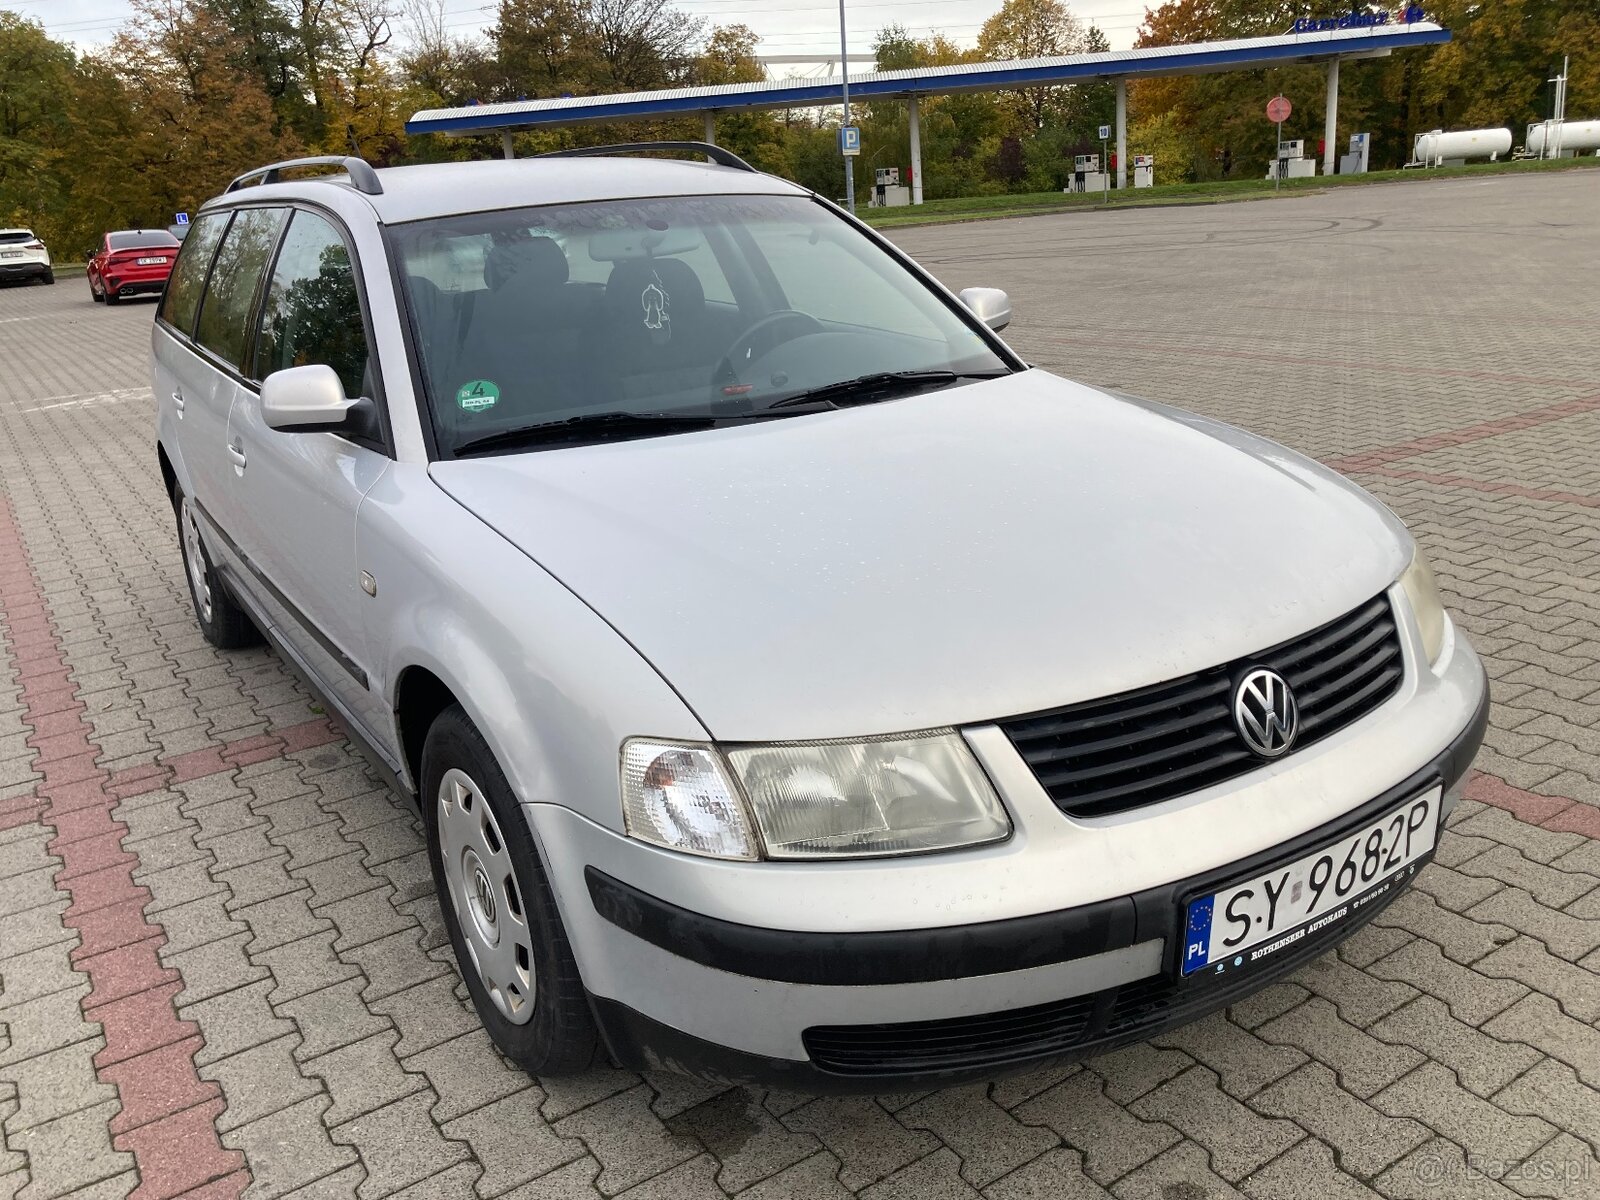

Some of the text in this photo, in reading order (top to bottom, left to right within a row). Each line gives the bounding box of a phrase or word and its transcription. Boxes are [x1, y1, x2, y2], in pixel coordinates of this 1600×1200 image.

[846, 130, 857, 148] P
[472, 381, 485, 396] 4
[1222, 799, 1429, 947] SY 9682P
[1307, 907, 1348, 934] AUTOHAUS
[1187, 940, 1206, 961] PL
